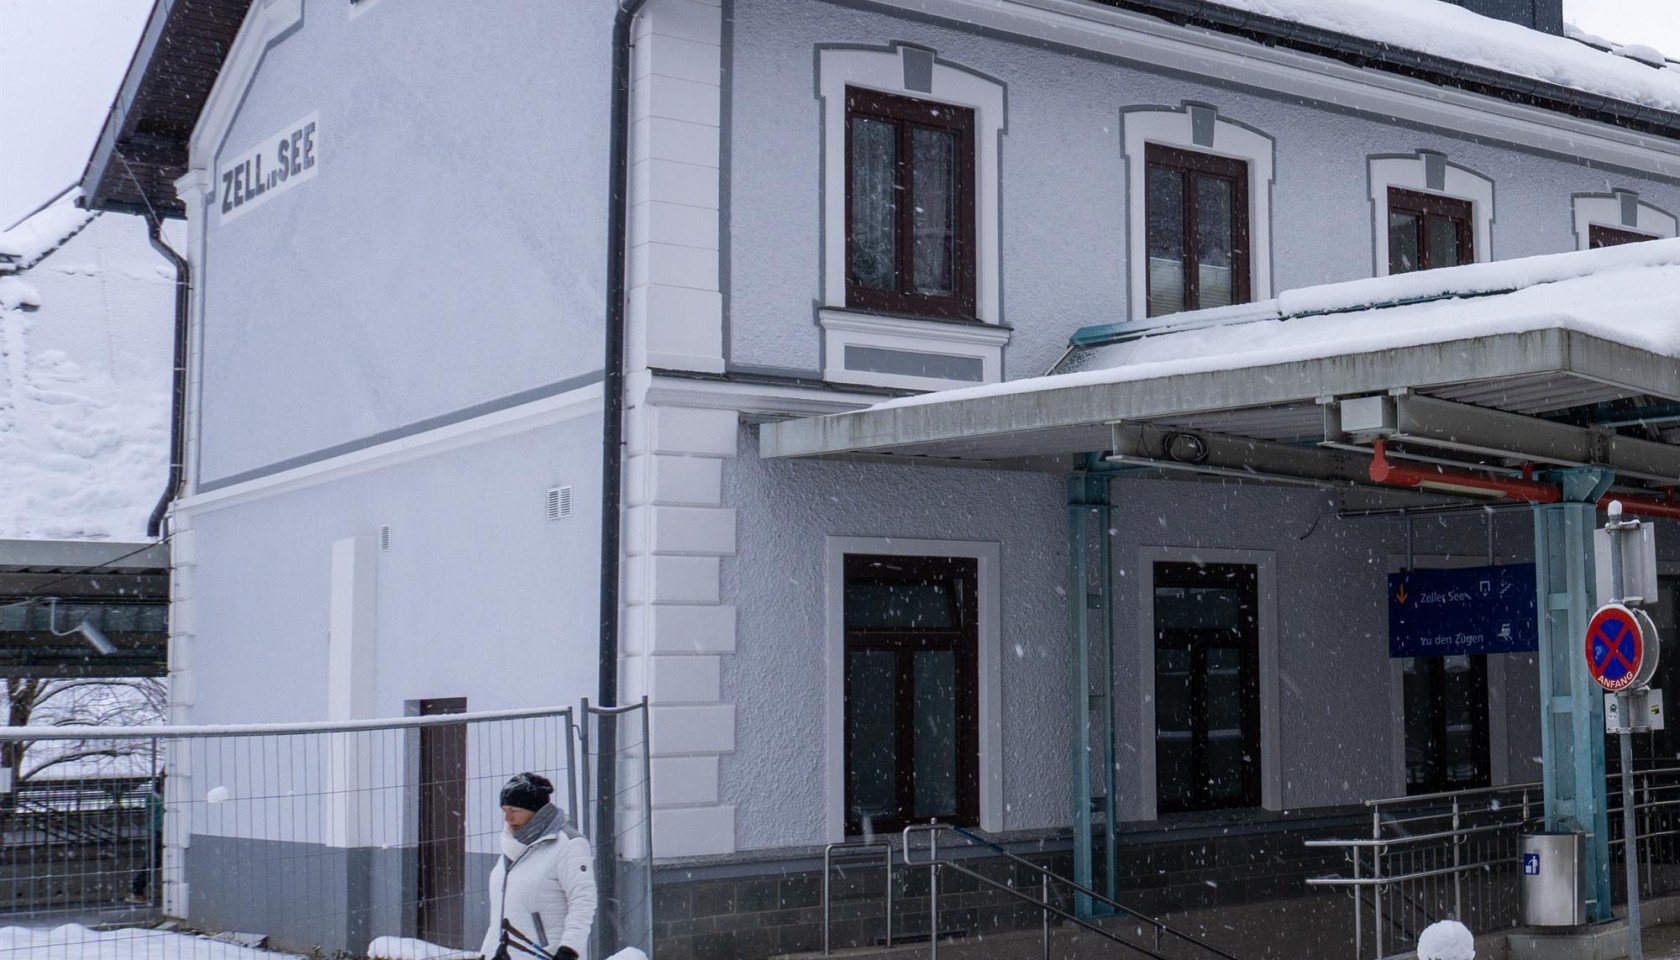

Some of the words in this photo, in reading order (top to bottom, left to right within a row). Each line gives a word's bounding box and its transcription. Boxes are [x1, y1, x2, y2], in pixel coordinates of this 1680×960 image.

[222, 153, 265, 215] ZELL
[278, 122, 316, 182] SEE
[1420, 591, 1446, 603] Zeller
[1448, 590, 1466, 602] See
[1420, 636, 1432, 646] zu
[1434, 634, 1452, 645] den
[1597, 671, 1634, 689] ANFANG
